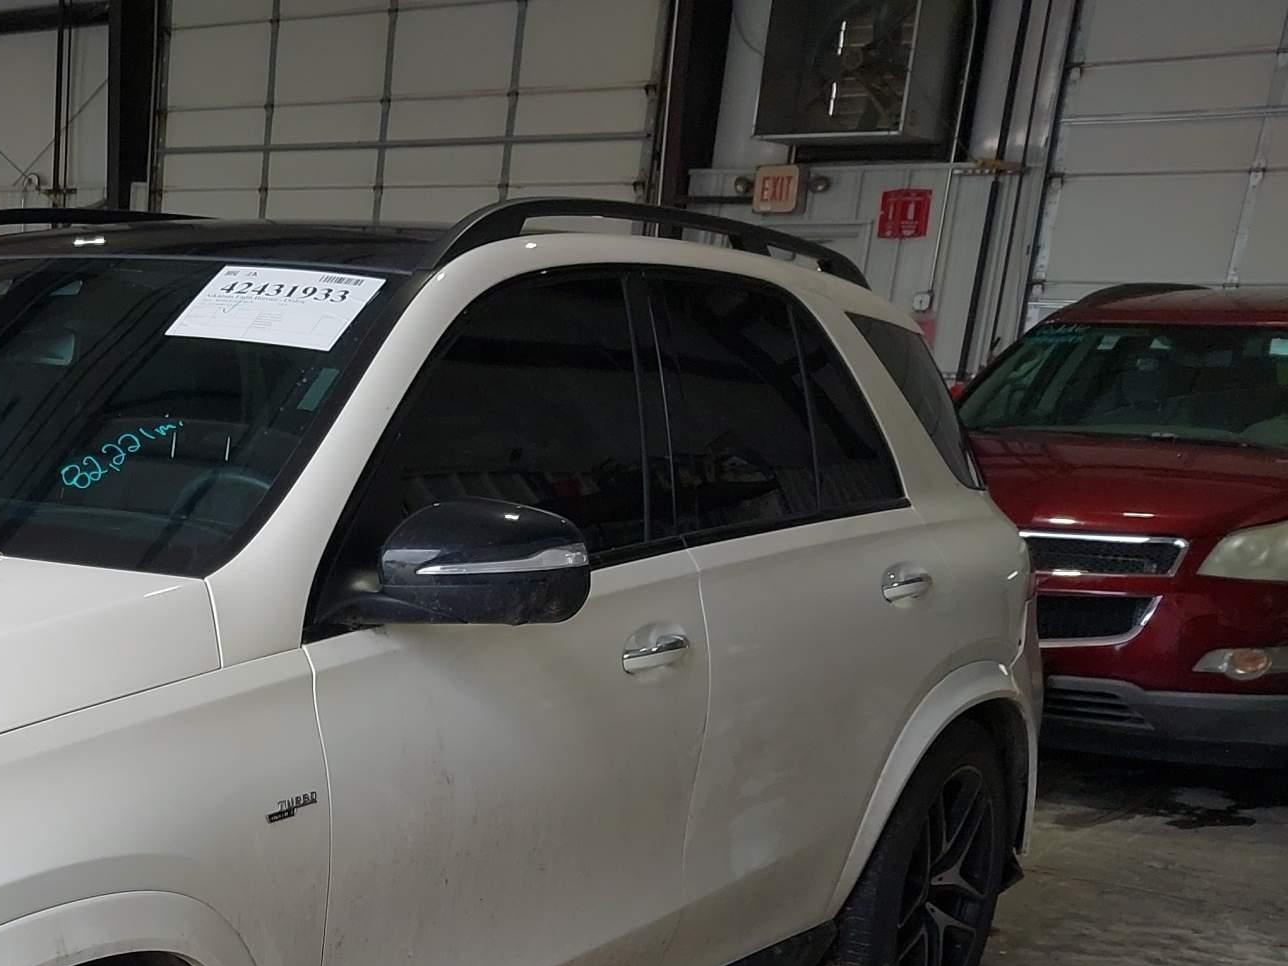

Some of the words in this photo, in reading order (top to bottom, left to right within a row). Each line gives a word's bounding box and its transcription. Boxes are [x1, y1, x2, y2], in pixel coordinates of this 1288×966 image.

[760, 175, 793, 202] EXIT
[220, 281, 350, 303] 42431933
[277, 791, 318, 812] TURBO
